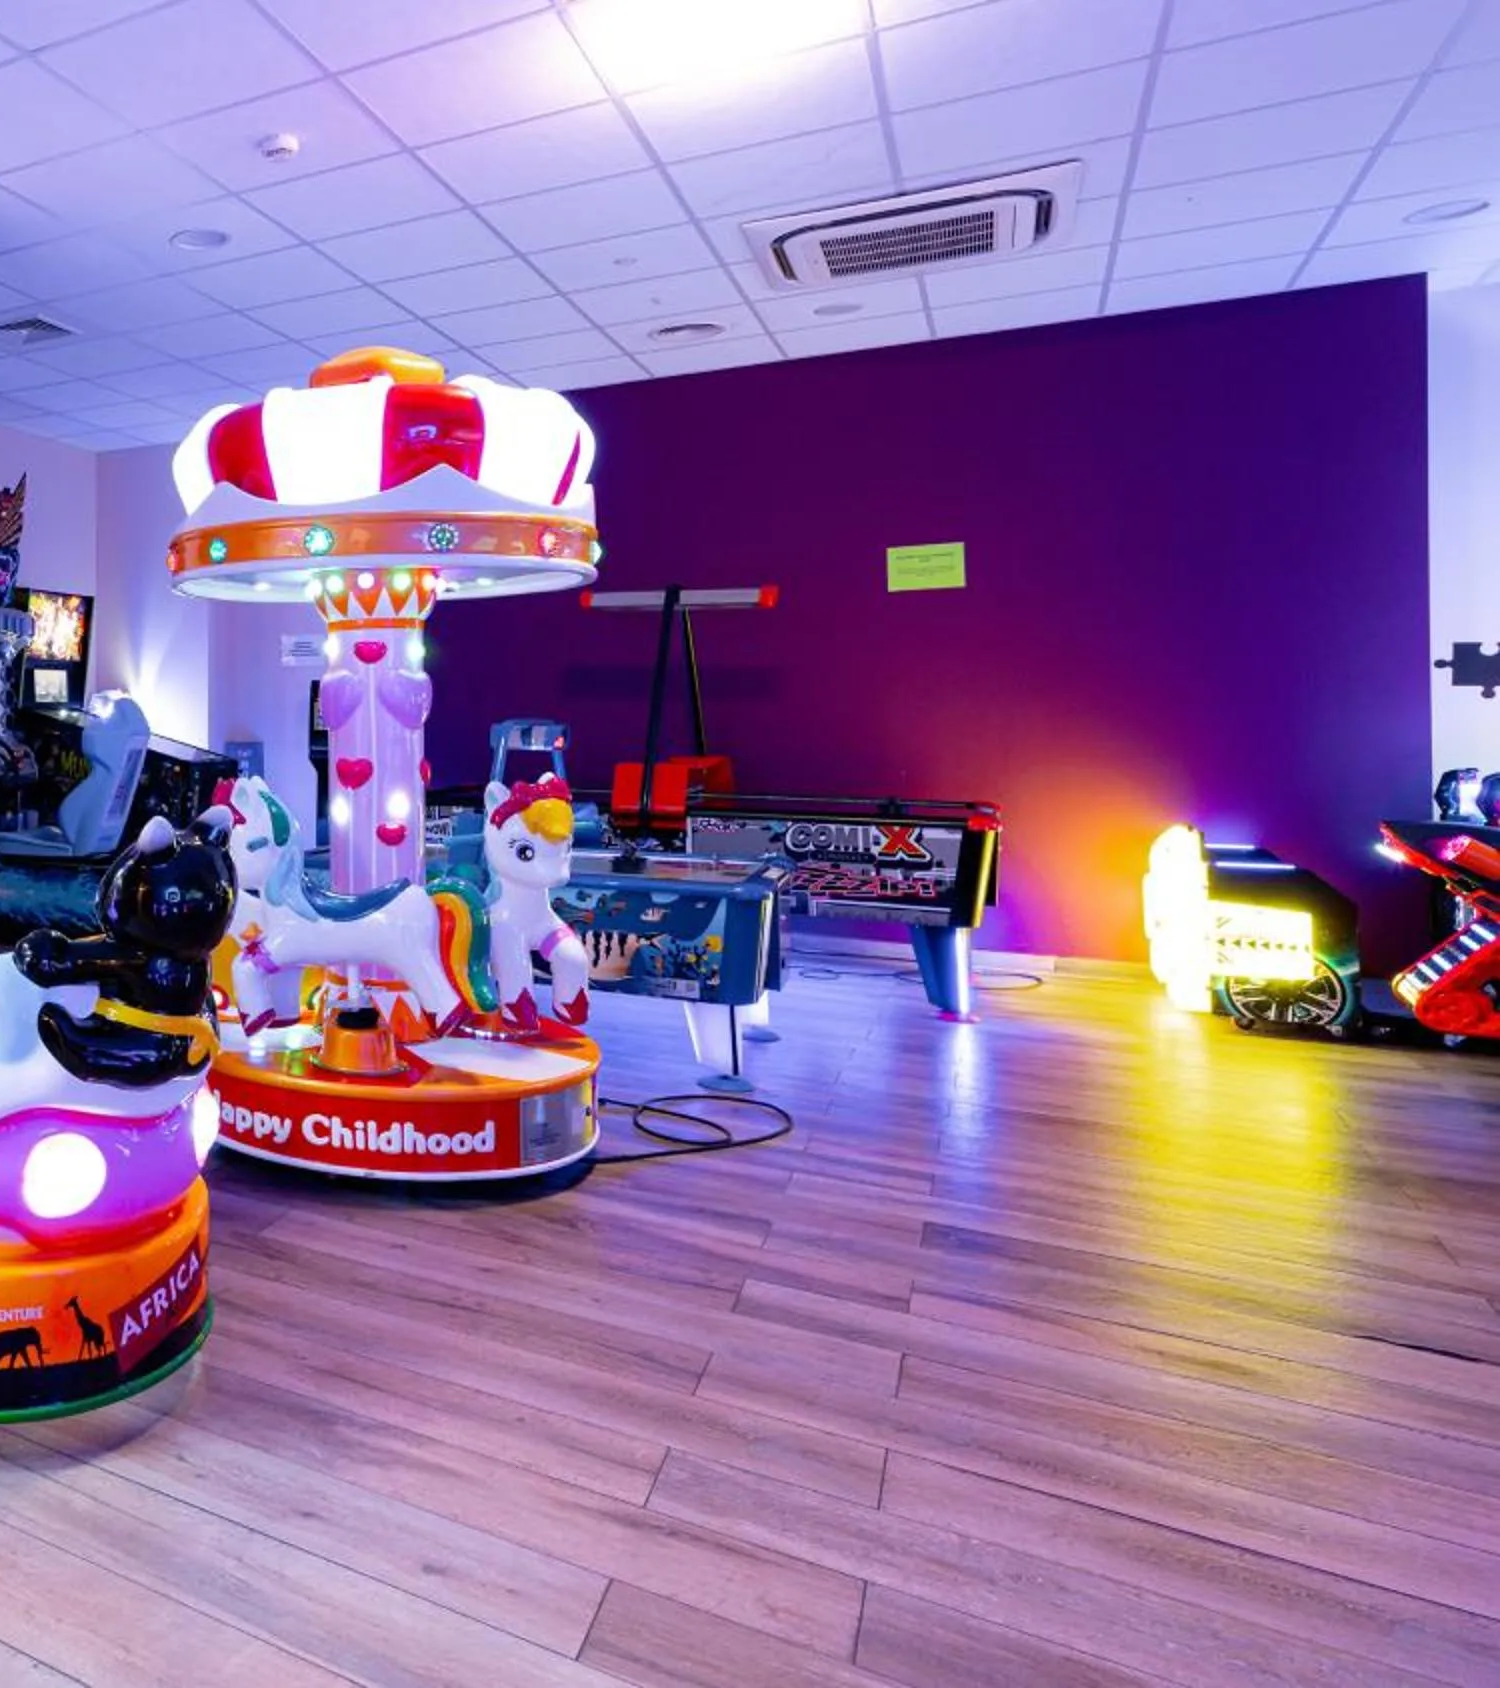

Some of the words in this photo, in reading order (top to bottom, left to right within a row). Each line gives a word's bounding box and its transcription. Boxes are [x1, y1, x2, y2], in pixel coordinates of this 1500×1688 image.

[213, 1089, 292, 1144] appy
[302, 1113, 496, 1154] Childhood
[120, 1248, 200, 1347] AFRICA
